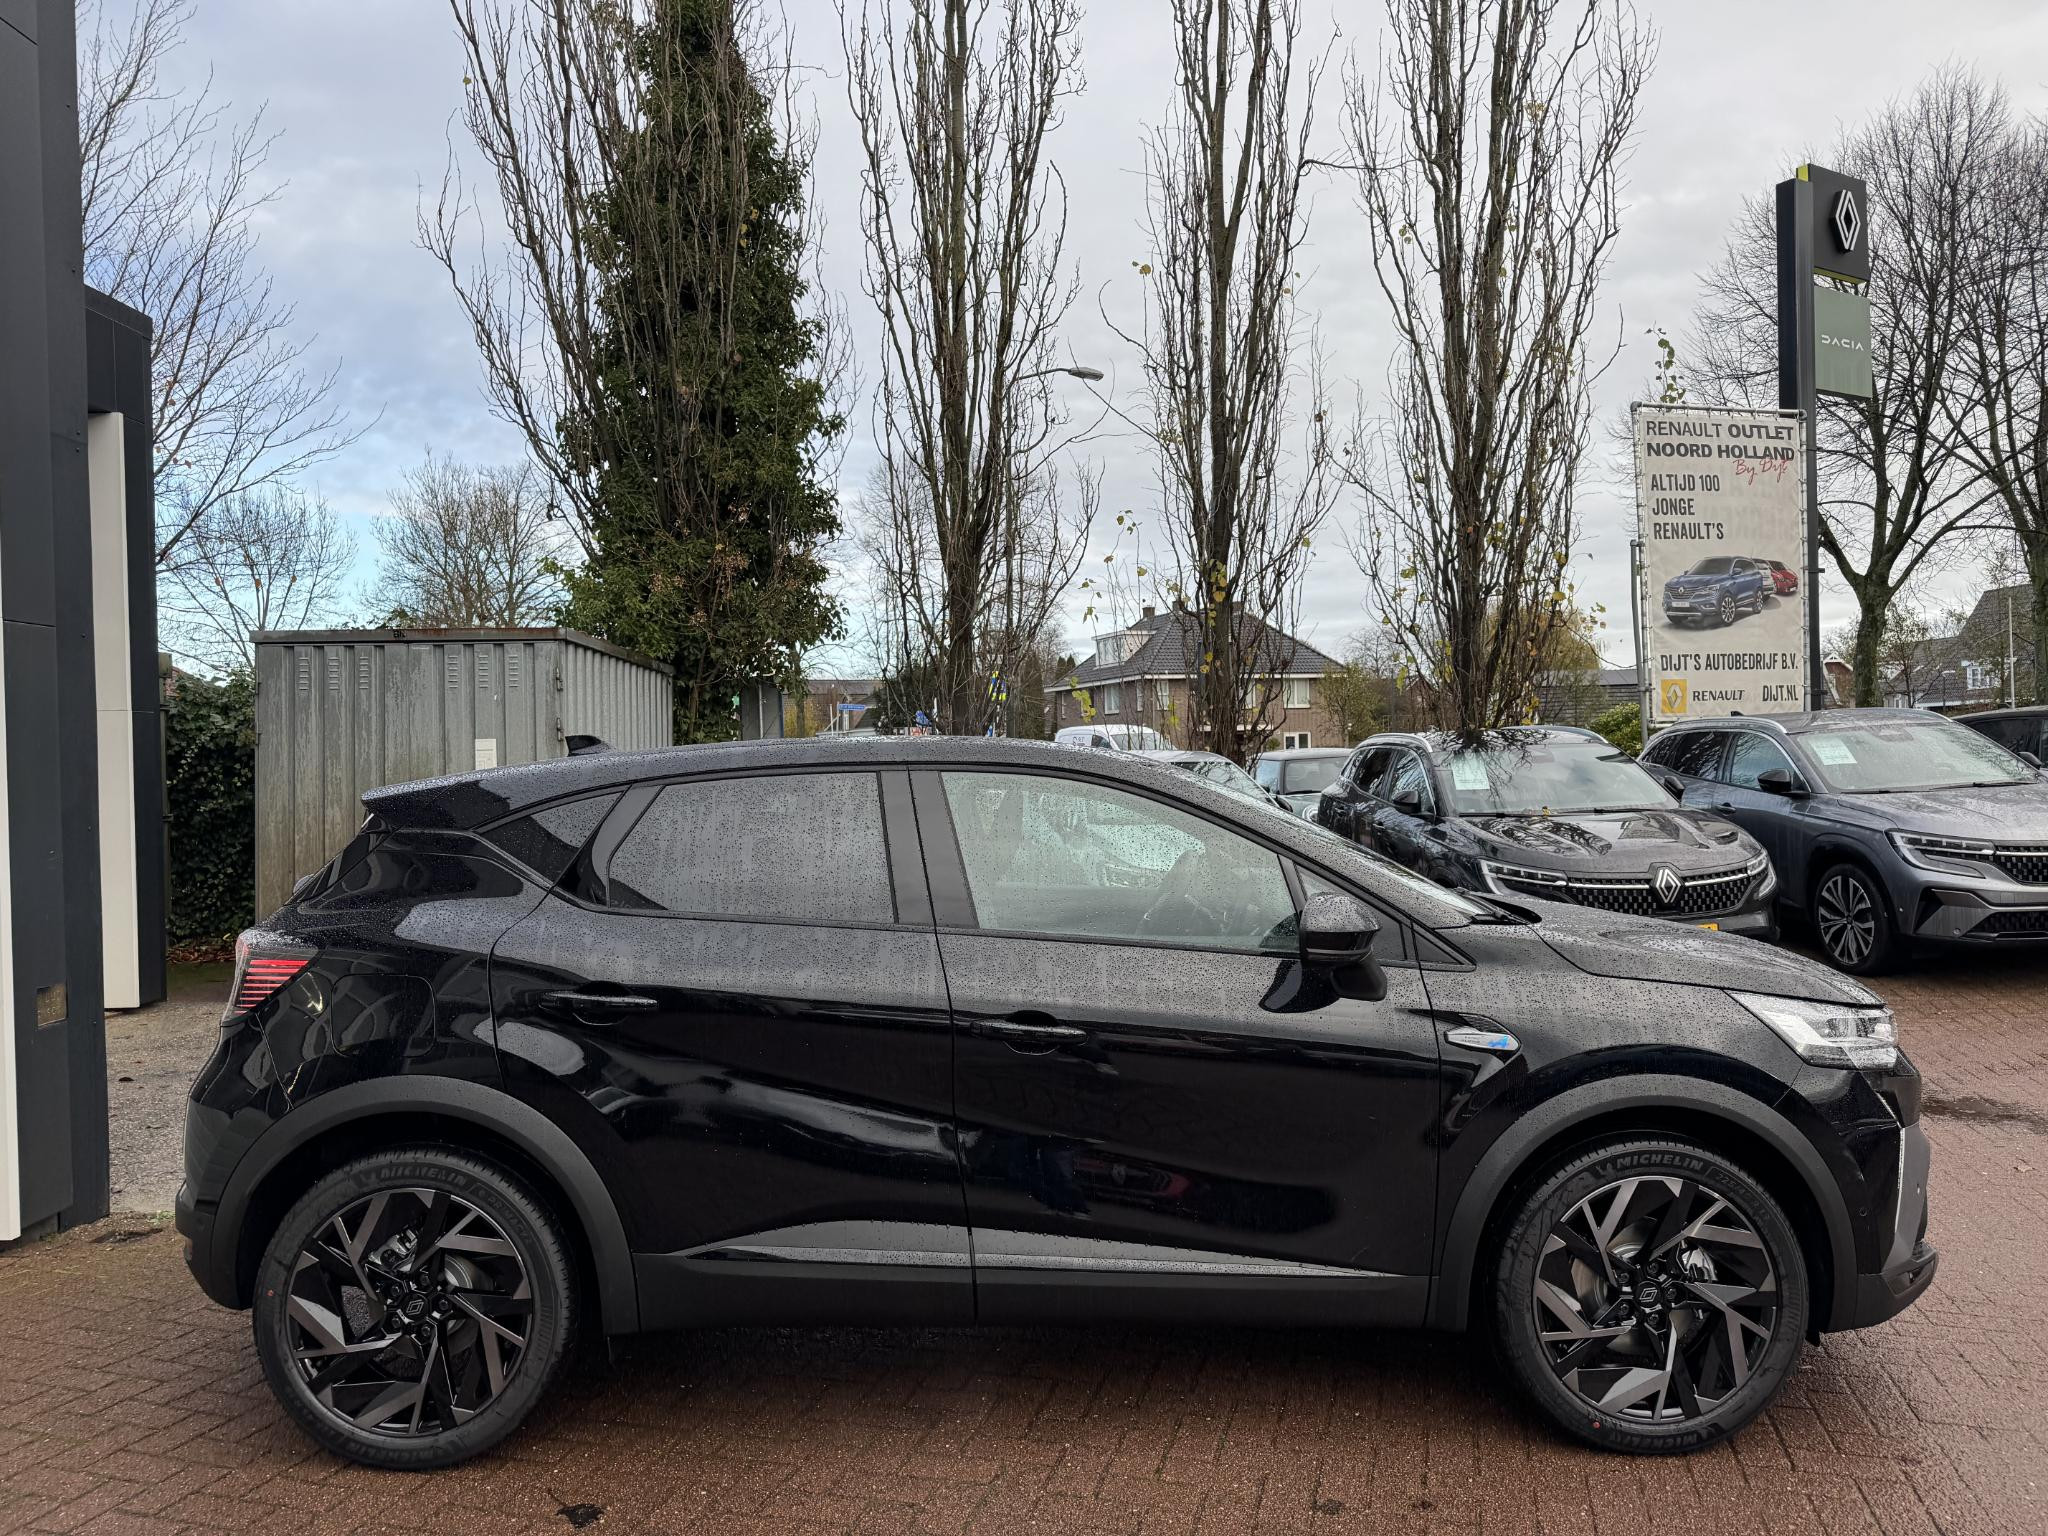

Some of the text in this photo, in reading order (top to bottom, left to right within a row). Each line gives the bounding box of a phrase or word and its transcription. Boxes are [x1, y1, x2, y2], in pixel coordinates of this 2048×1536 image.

[1821, 334, 1864, 351] DACIA
[1646, 421, 1794, 440] RENAULT OUTLET
[1646, 442, 1795, 461] NOORD HOLLAND
[1732, 459, 1757, 485] By
[1651, 473, 1720, 492] ALTIJD 100
[1652, 497, 1695, 516] JONGE
[1653, 522, 1724, 540] RENAULT'S
[1660, 652, 1799, 671] DIJT'S AUTOBEDRIJF B.V.
[1692, 689, 1745, 702] RENAULT
[1762, 684, 1799, 702] DIJT.NL
[1617, 1154, 1704, 1170] MICHELIN
